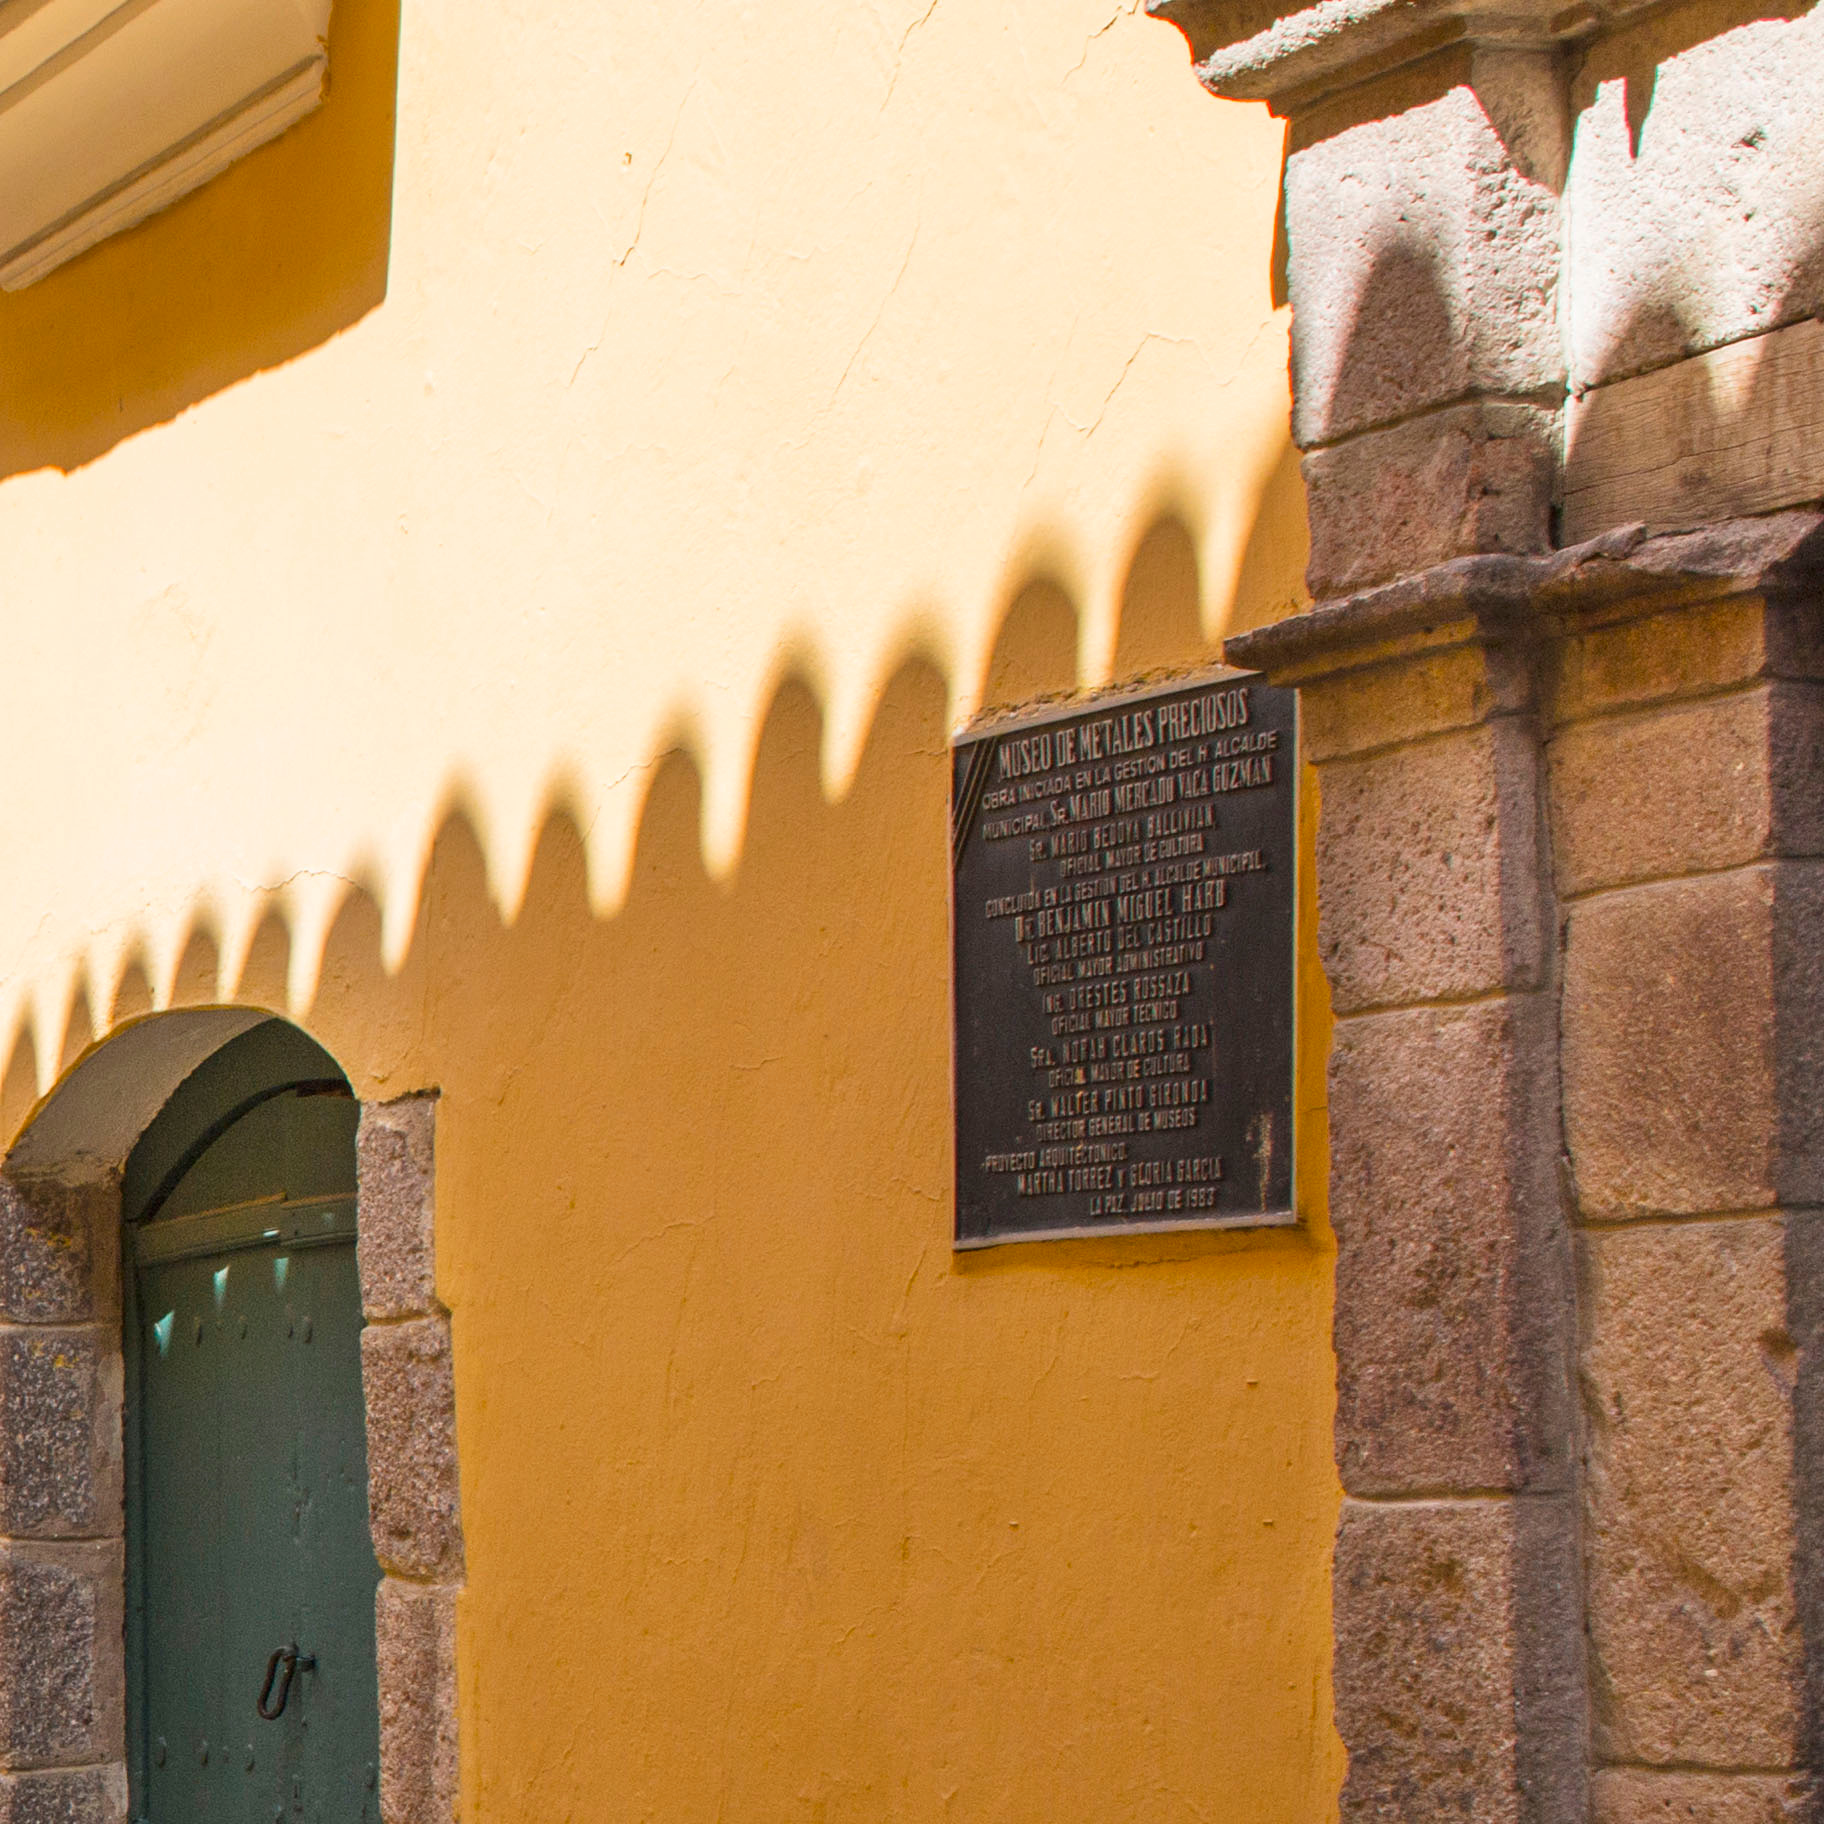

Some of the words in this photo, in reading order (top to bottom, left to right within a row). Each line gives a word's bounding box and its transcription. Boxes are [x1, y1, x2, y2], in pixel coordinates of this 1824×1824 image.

[999, 733, 1052, 780] MUSEO
[1056, 727, 1076, 767] DE
[1079, 711, 1155, 761] METALES
[1158, 688, 1248, 744] PRECIOSOS
[982, 788, 1016, 810] OBRA
[1018, 775, 1072, 803] INICIADA
[1075, 770, 1092, 789] EN
[1095, 767, 1111, 785] LA
[1114, 752, 1166, 780] GESTION
[1169, 748, 1194, 768] DEL
[1215, 730, 1278, 758] ALCALDE
[1070, 789, 1111, 820] MARIO
[1114, 776, 1174, 814] MERCADO
[1178, 768, 1211, 798] VACA
[1213, 755, 1272, 792] GUZMAN
[1051, 830, 1089, 857] MARIO
[1093, 820, 1140, 849] BEDOYA
[1060, 853, 1101, 877] OFICIAL
[1105, 844, 1142, 869] MAYOR
[1144, 841, 1158, 862] DE
[1159, 832, 1204, 858] CULTURA
[985, 890, 1041, 918] CONCLUIDA
[1044, 887, 1058, 907] EN
[1060, 884, 1072, 904] LA
[1075, 876, 1118, 900] GESTION
[1119, 872, 1139, 893] DEL
[1154, 860, 1201, 886] ALCALDE
[1038, 900, 1111, 936] BENJAMIN
[1117, 888, 1174, 923] MIGUEL
[1182, 879, 1226, 913] HARB
[1056, 929, 1112, 960] ALBERTO
[1117, 925, 1140, 950] DEL
[1148, 913, 1212, 944] CASTILLO
[1033, 962, 1074, 986] OFICIAL
[1078, 956, 1112, 978] MAYOR
[1116, 941, 1205, 973] ADMINISTRATIVO
[1069, 980, 1128, 1010] ORESTES
[1051, 1012, 1091, 1036] OFICIAL
[1095, 1006, 1130, 1028] MAYOR
[1133, 1000, 1177, 1023] TECNICO
[1063, 1037, 1107, 1064] NORAH
[1112, 1028, 1165, 1057] CLAROS
[1048, 1066, 1087, 1088] OFICIAL
[1090, 1060, 1125, 1082] MAYOR
[1127, 1058, 1141, 1079] DE
[1143, 1053, 1191, 1076] CULTURA
[1051, 1089, 1098, 1117] WALTER
[1104, 1085, 1145, 1112] PINTO
[1036, 1119, 1086, 1142] DIRECTOR
[1088, 1113, 1136, 1137] GENERAL
[1138, 1111, 1152, 1131] DE
[1153, 1106, 1197, 1129] MUSEOS
[985, 1152, 1036, 1172] PROYECTO
[1017, 1171, 1064, 1195] MARTHA
[1068, 1165, 1113, 1191] TORREZ
[1129, 1160, 1174, 1186] GLORIA
[1177, 1156, 1224, 1182] GARCIA
[1089, 1195, 1103, 1216] LA
[1167, 1188, 1182, 1209] DE
[1186, 1186, 1217, 1208] 1983
